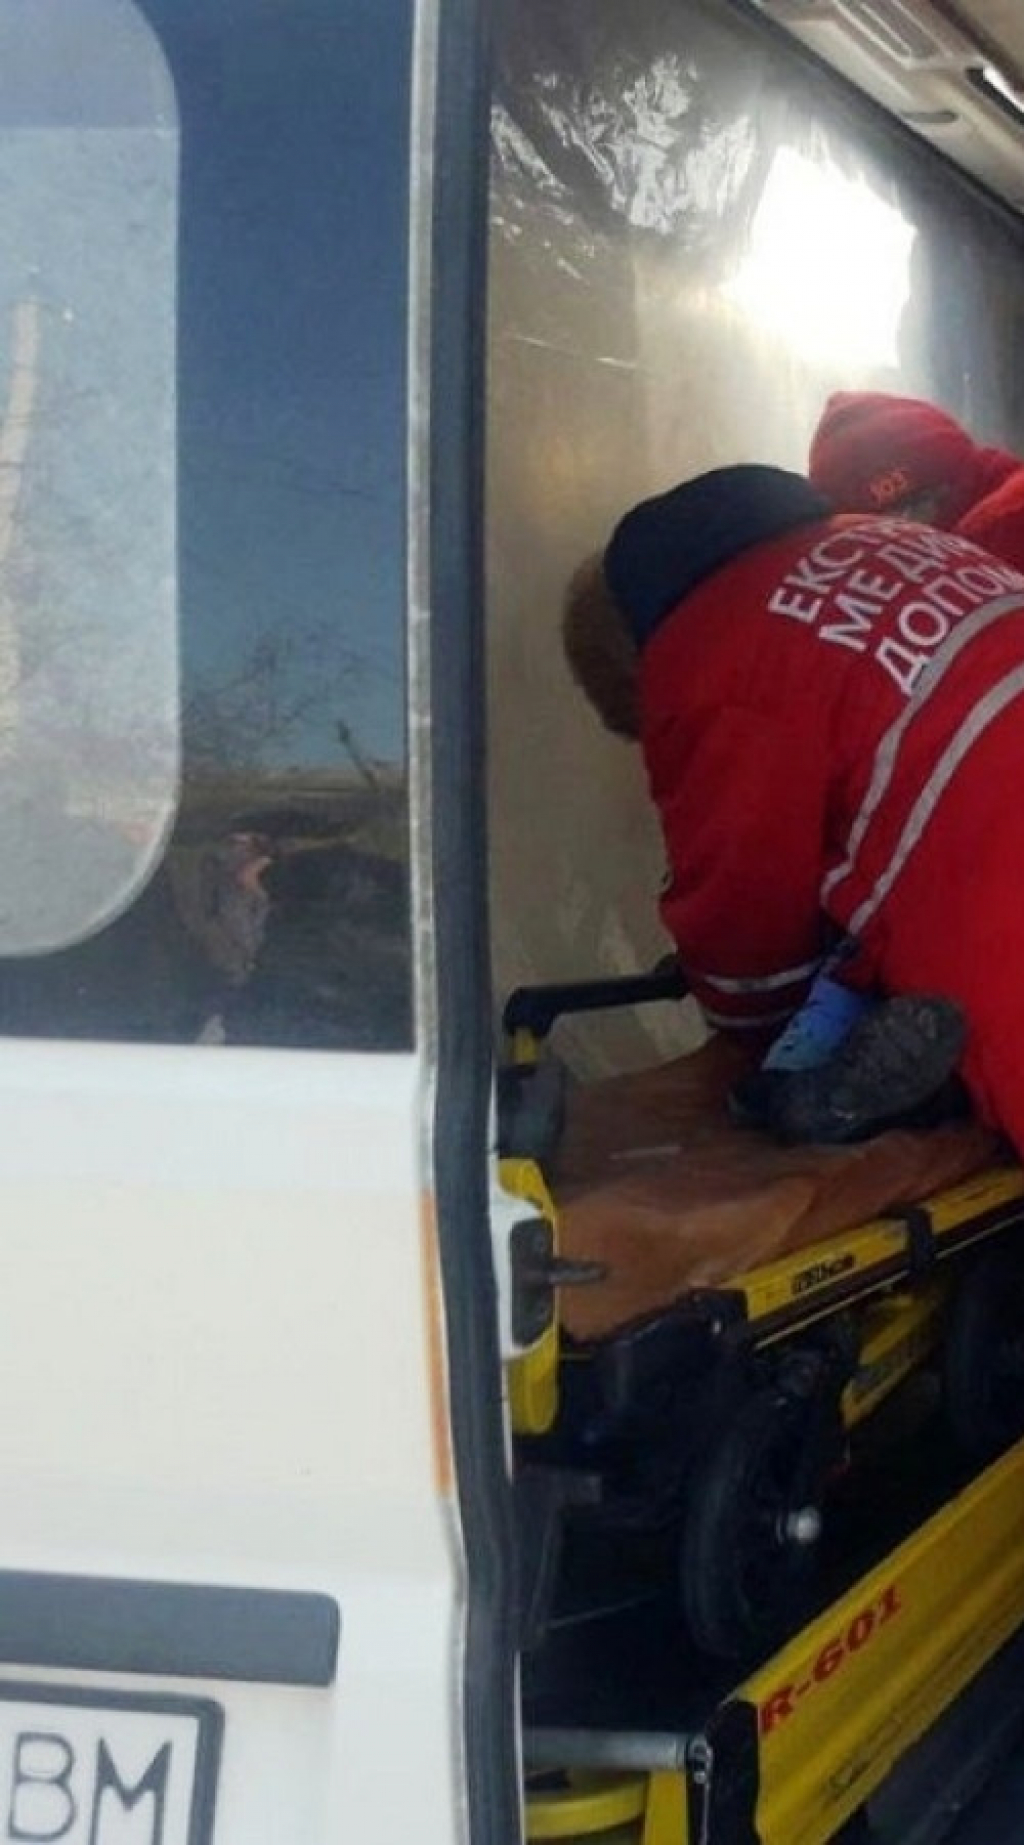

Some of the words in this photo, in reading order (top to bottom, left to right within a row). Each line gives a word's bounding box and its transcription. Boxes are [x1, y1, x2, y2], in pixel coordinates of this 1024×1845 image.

[768, 519, 915, 623] ЕКСТ
[818, 532, 986, 651] МЕДИ
[760, 1584, 901, 1735] R-601
